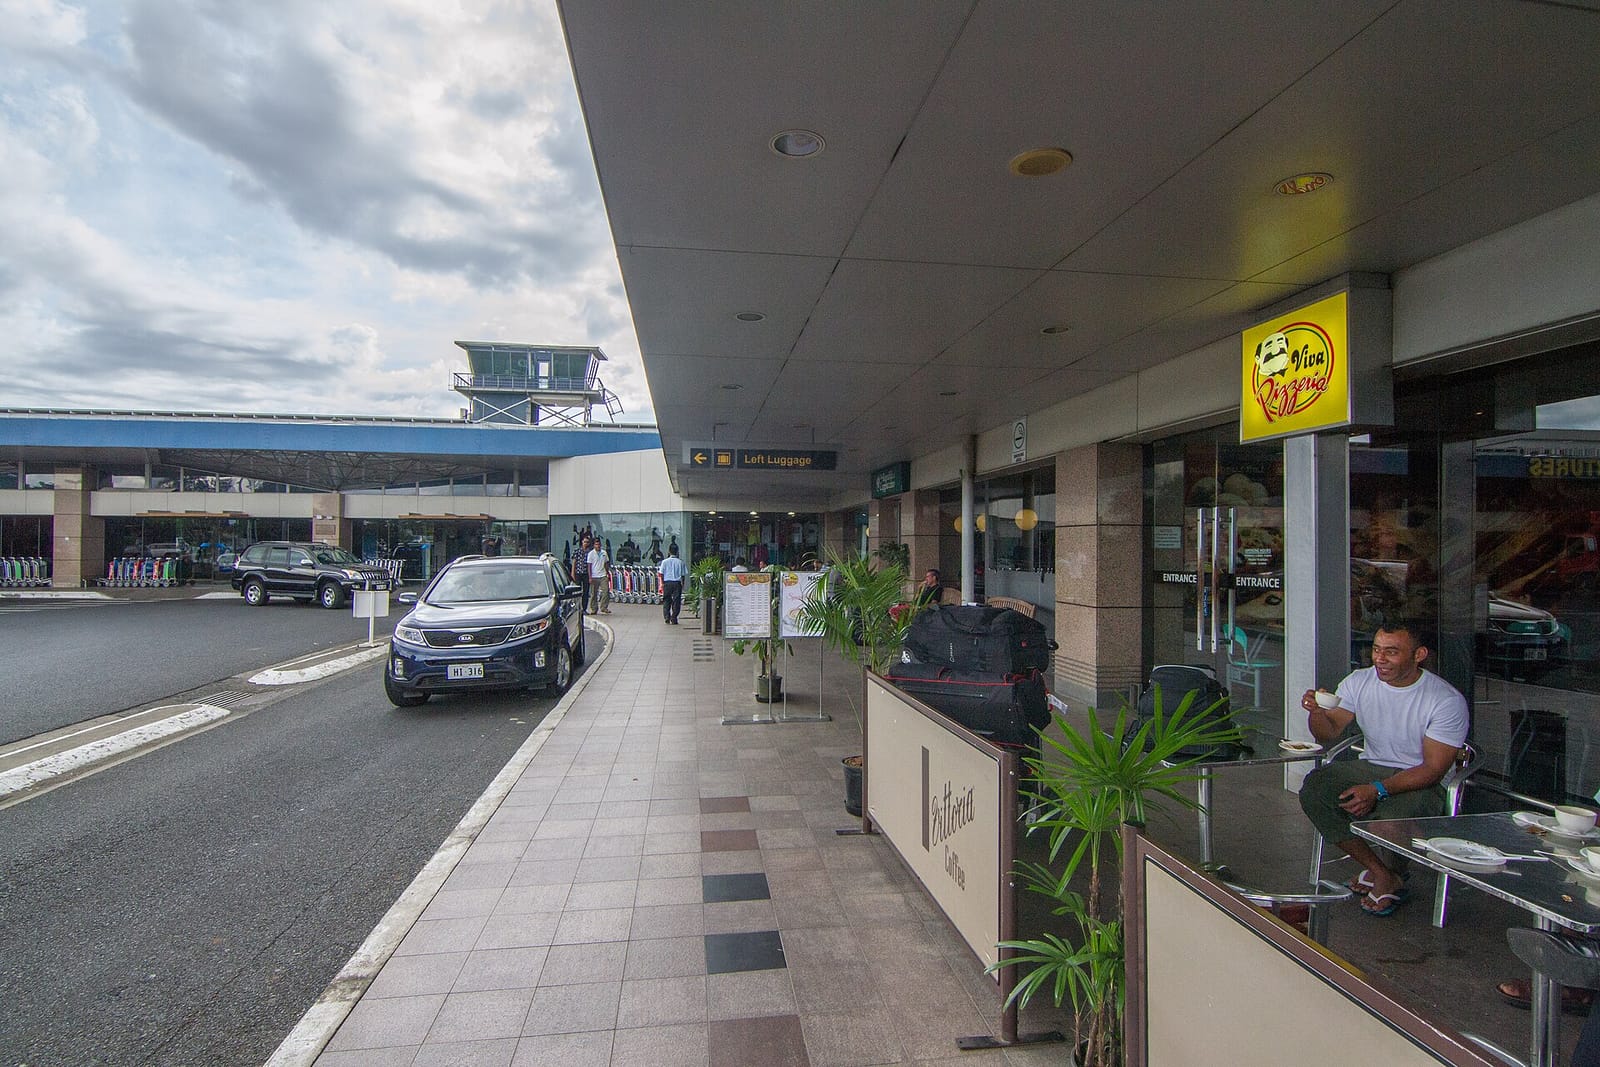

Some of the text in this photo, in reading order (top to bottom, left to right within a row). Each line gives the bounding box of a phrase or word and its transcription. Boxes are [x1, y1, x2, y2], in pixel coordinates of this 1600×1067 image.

[1291, 344, 1324, 372] Viva
[1256, 372, 1328, 423] Pizzeria
[744, 454, 812, 467] Left Luggage
[1163, 573, 1197, 583] ENTRANCE
[1235, 577, 1280, 588] ENTRANCE
[459, 634, 474, 642] KIA
[468, 666, 483, 676] 316
[931, 781, 975, 847] Vittoria
[944, 845, 966, 891] Coffee
